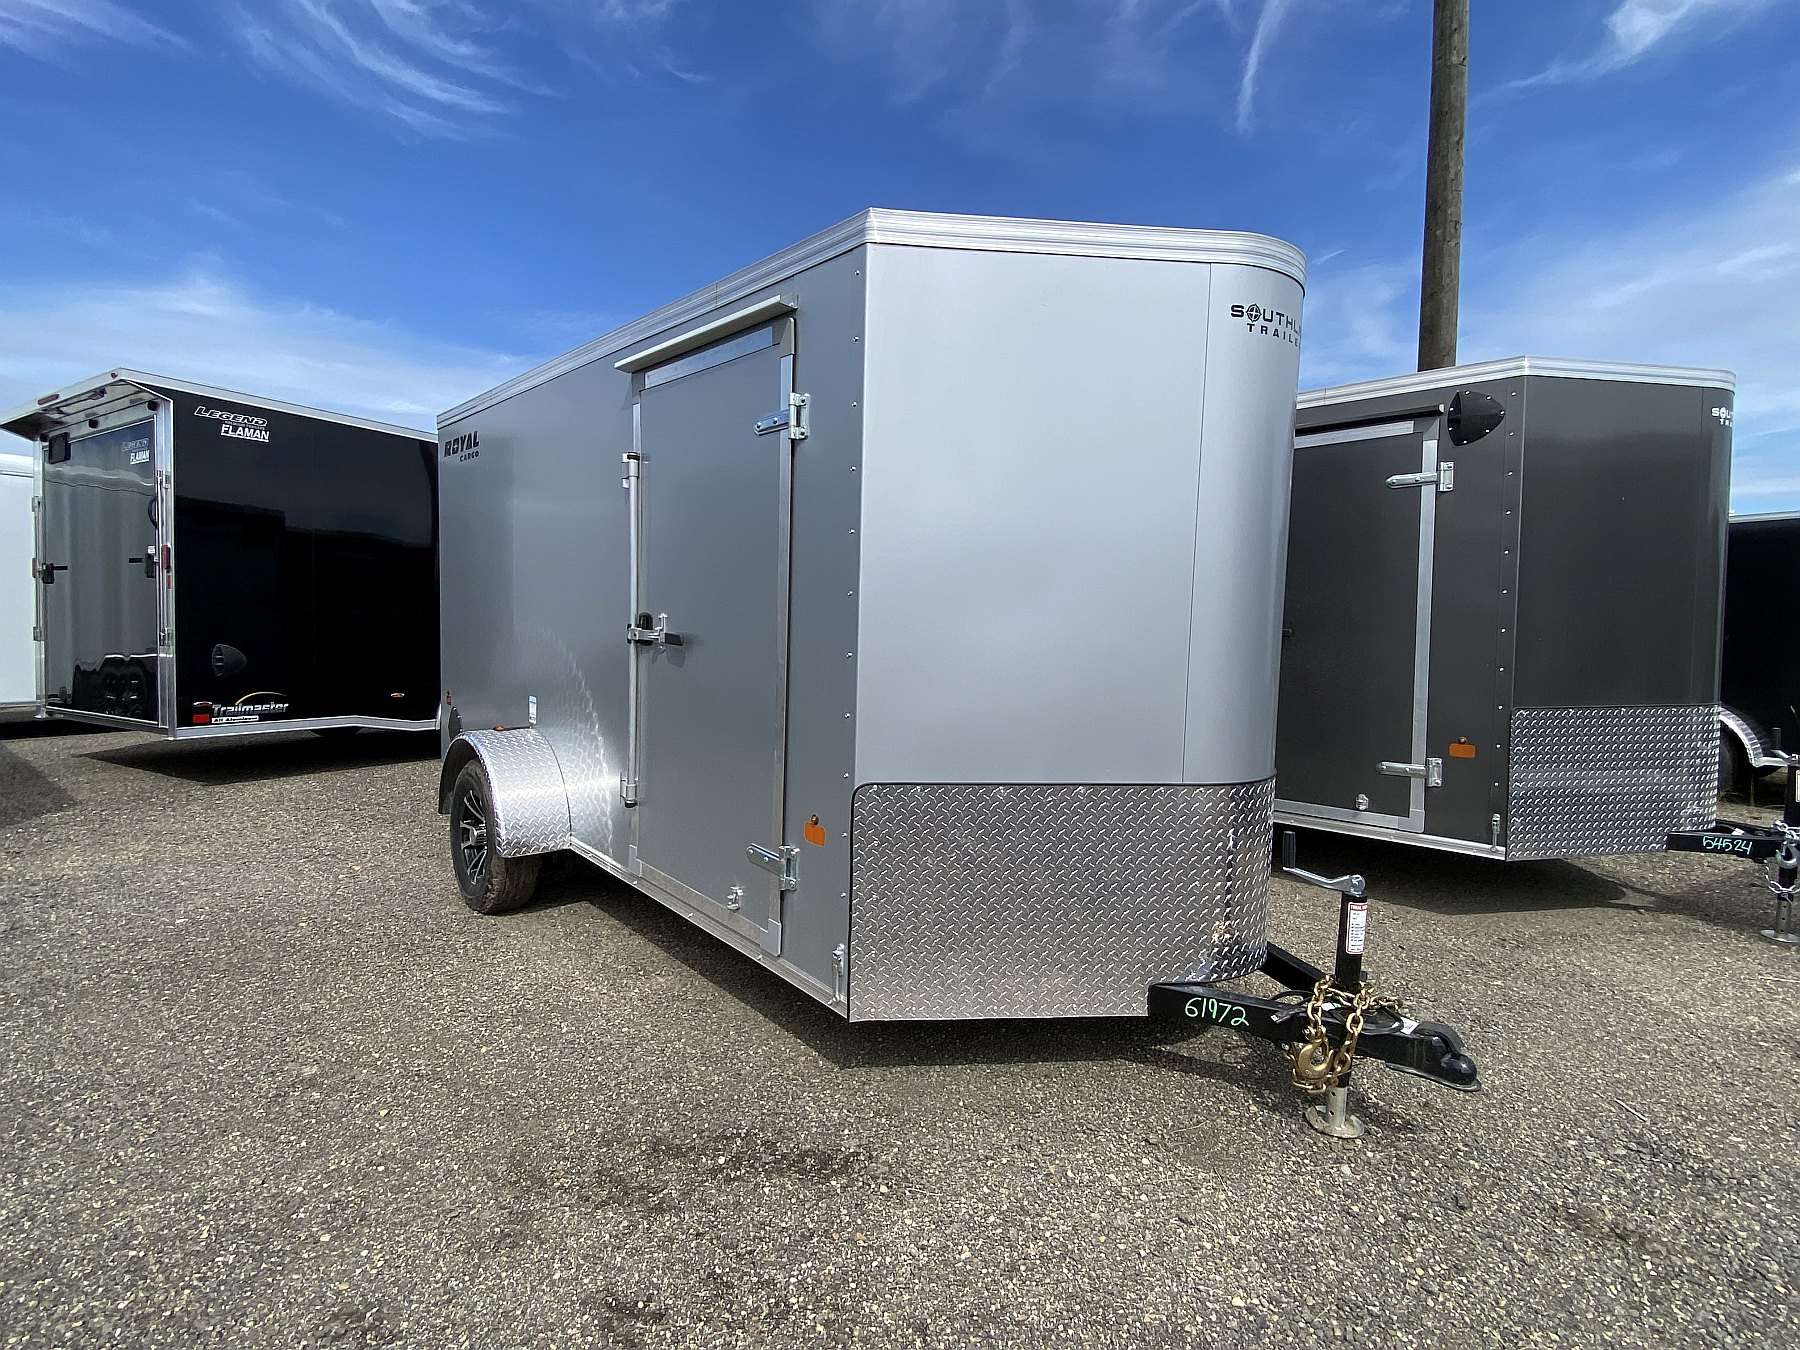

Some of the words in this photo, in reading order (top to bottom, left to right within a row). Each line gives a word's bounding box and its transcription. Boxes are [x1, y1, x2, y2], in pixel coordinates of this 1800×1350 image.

[194, 406, 267, 426] LEGEND
[221, 424, 269, 440] FLAMAN
[444, 431, 479, 457] ROYAL
[130, 450, 150, 462] FLAMAN
[460, 450, 479, 462] CARGO
[212, 702, 288, 716] Trailmaster
[1703, 836, 1752, 854] 54524
[1185, 997, 1249, 1026] 61972
